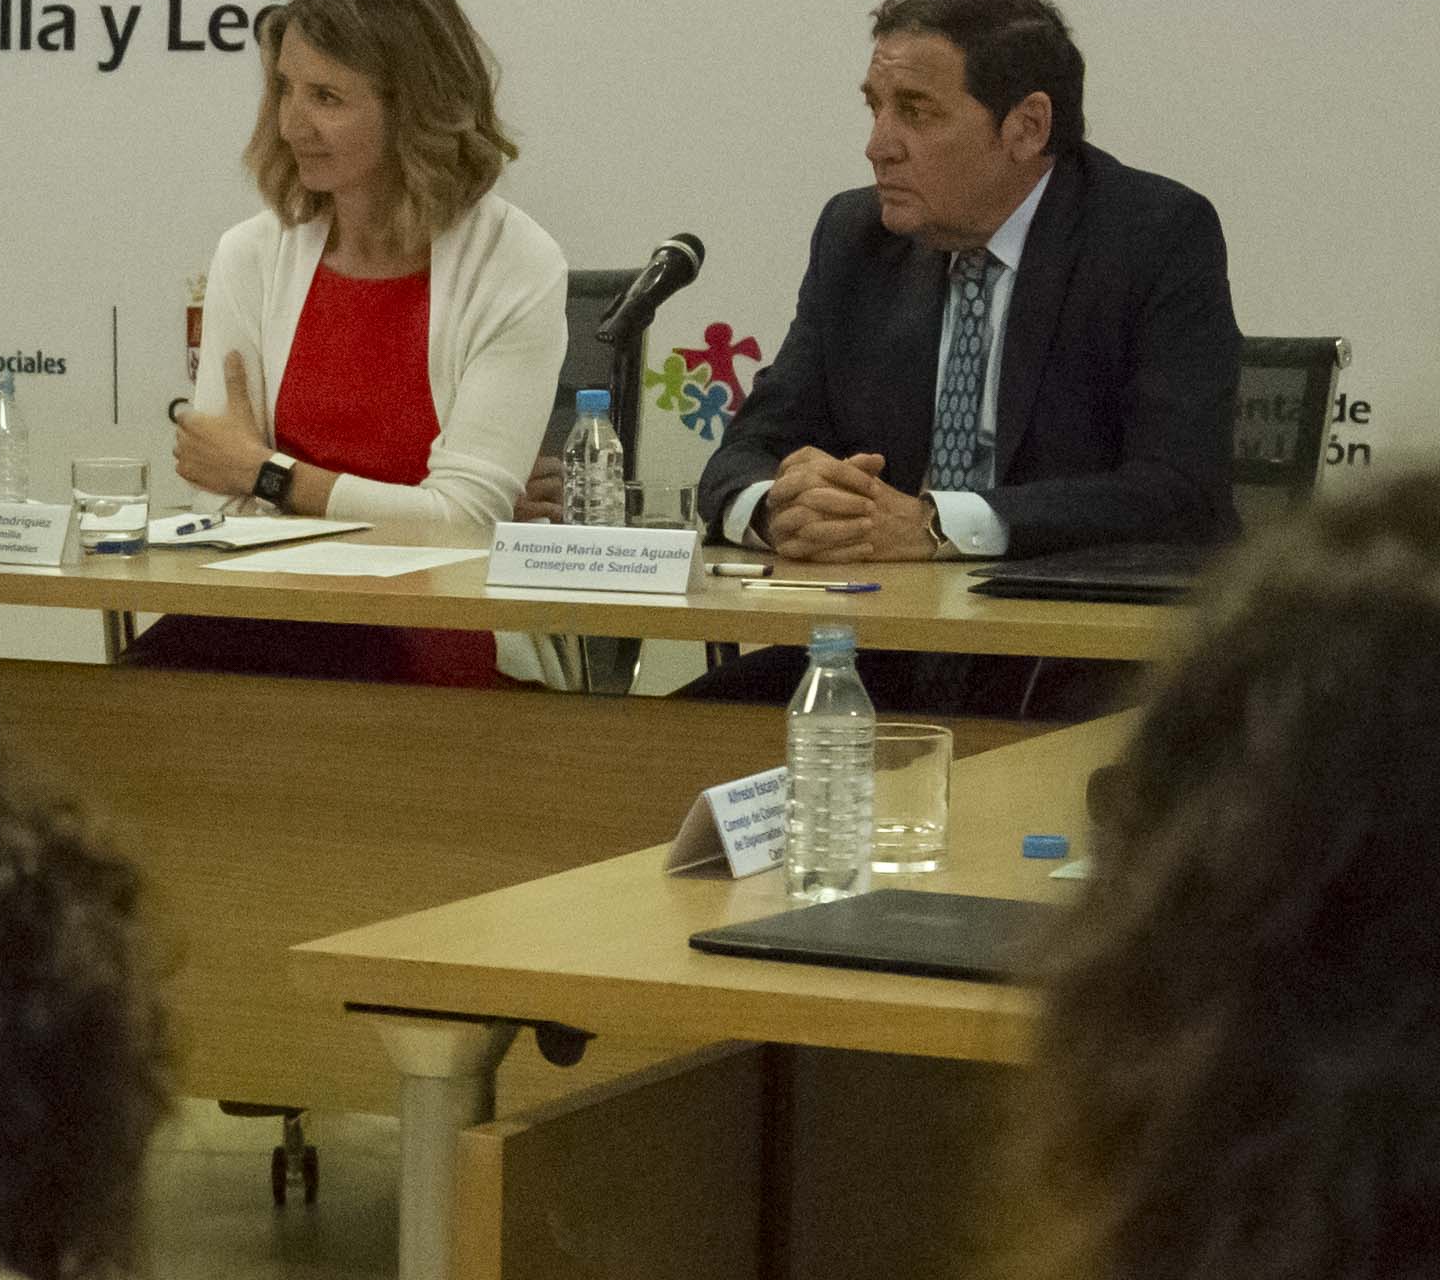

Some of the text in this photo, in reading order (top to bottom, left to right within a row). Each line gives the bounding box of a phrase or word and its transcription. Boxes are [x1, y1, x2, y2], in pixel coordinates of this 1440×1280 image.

[97, 5, 142, 73] y
[495, 541, 508, 552] D.
[512, 541, 562, 555] Antonio
[640, 547, 690, 560] Aguado
[524, 558, 657, 575] Consejero de Sanidad
